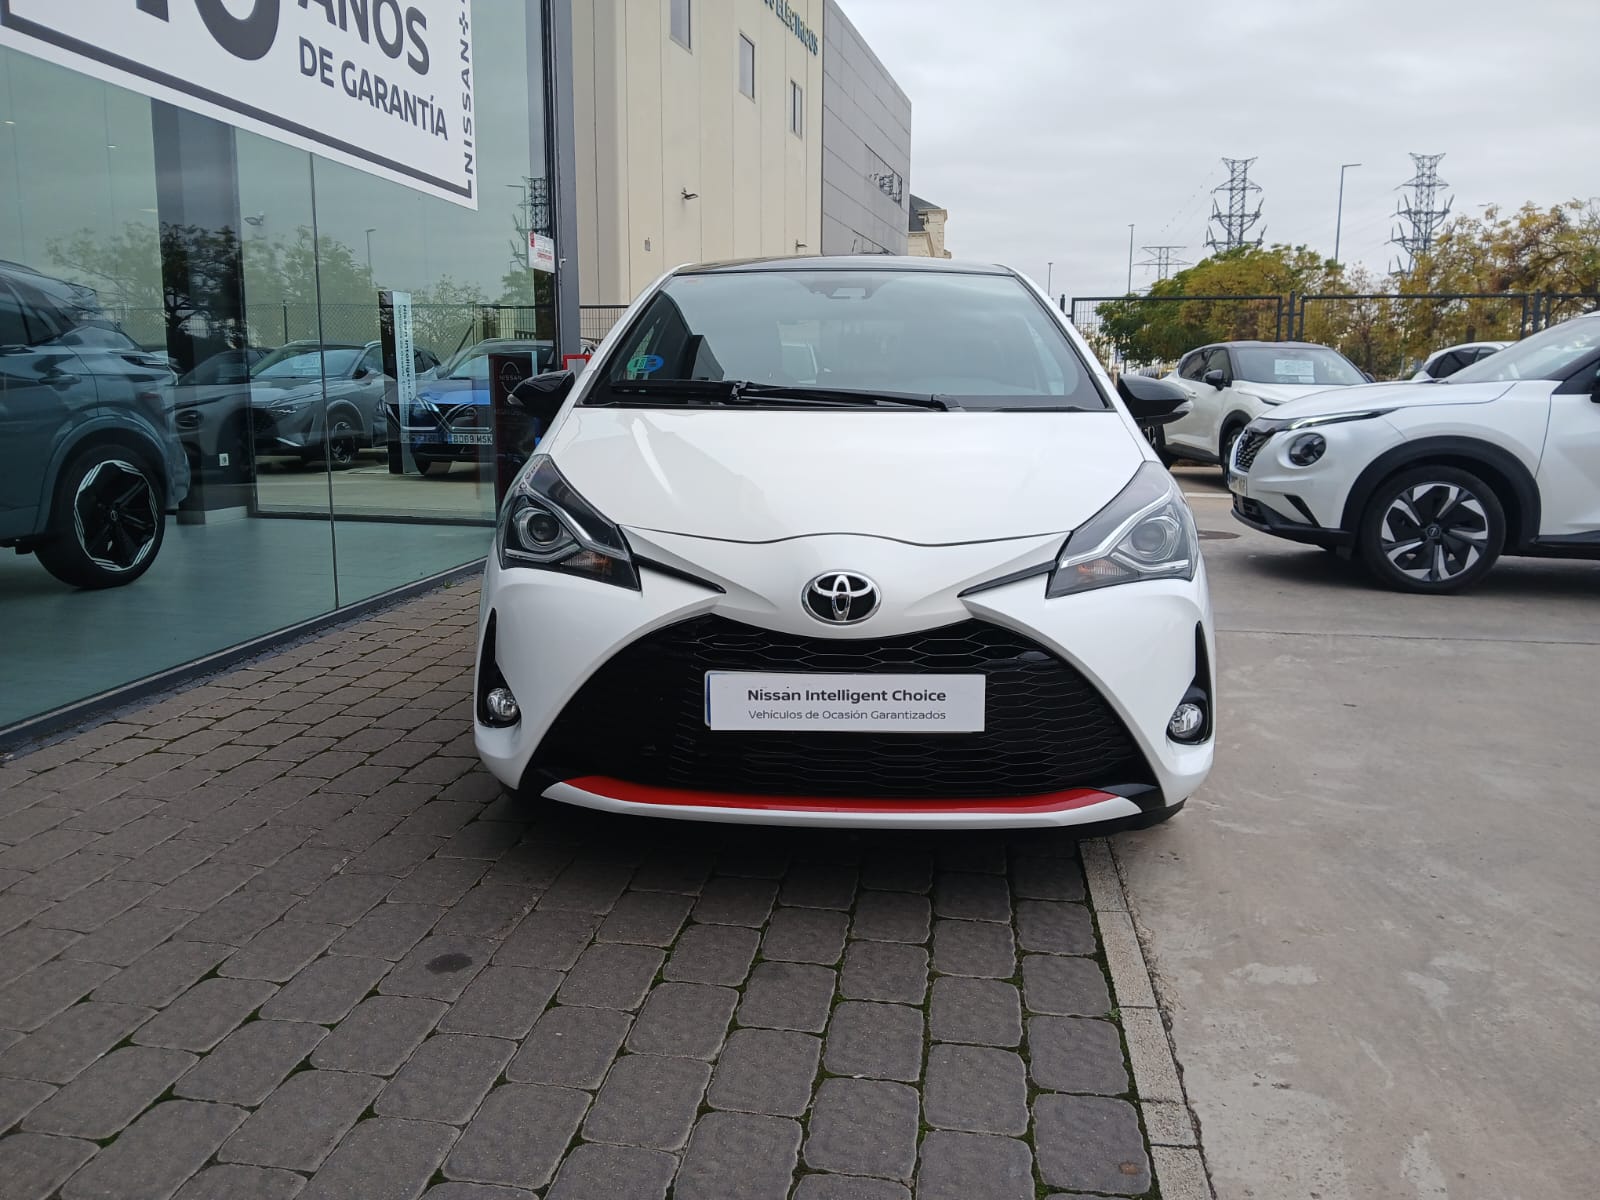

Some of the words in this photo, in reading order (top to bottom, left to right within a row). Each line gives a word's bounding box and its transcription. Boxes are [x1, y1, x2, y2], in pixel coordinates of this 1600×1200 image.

[298, 0, 430, 76] OS
[299, 35, 335, 88] DE
[341, 60, 448, 140] GARANTÍA
[460, 38, 474, 175] NISSAN
[747, 689, 801, 701] Nissan
[806, 689, 888, 704] Intelligent
[892, 689, 946, 701] Choice
[748, 709, 803, 720] Vehículos
[805, 710, 819, 720] de
[822, 709, 868, 720] Ocasión
[871, 710, 946, 720] Garantizados
